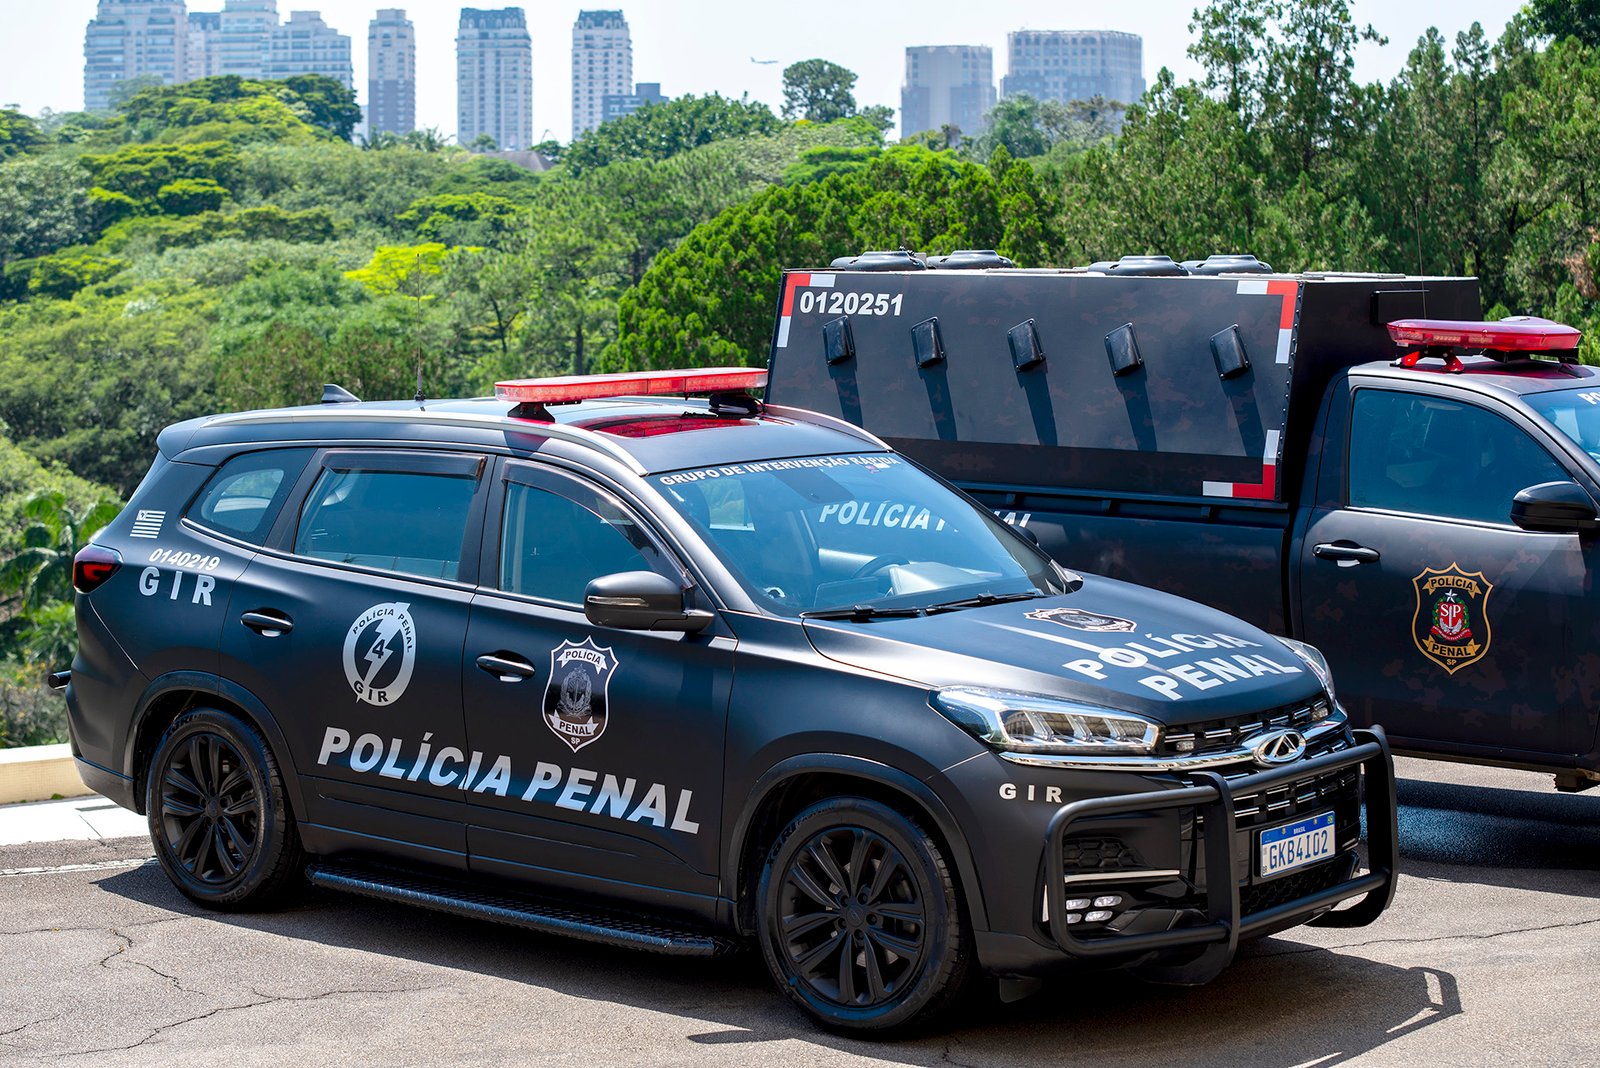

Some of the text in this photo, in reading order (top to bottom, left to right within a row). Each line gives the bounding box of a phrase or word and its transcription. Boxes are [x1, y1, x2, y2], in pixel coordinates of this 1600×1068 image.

[800, 291, 903, 316] 0120251
[659, 455, 902, 487] GRUPO DE INTERVENÇÃO RÁPIDA
[149, 548, 220, 571] 0140219
[1431, 576, 1473, 591] POLÍCIA
[353, 608, 413, 653] POLÍCIA PENAL
[372, 639, 385, 659] 4
[565, 648, 601, 665] POLÍCIA
[1062, 633, 1263, 681] POLÍCIA
[1432, 644, 1471, 657] PENAL
[1138, 654, 1303, 701] PENAL
[559, 722, 592, 735] PENAL
[571, 736, 580, 745] SP
[317, 726, 512, 798] POLÍCIA
[521, 761, 702, 834] PENAL
[1269, 829, 1328, 869] GKB4I02
